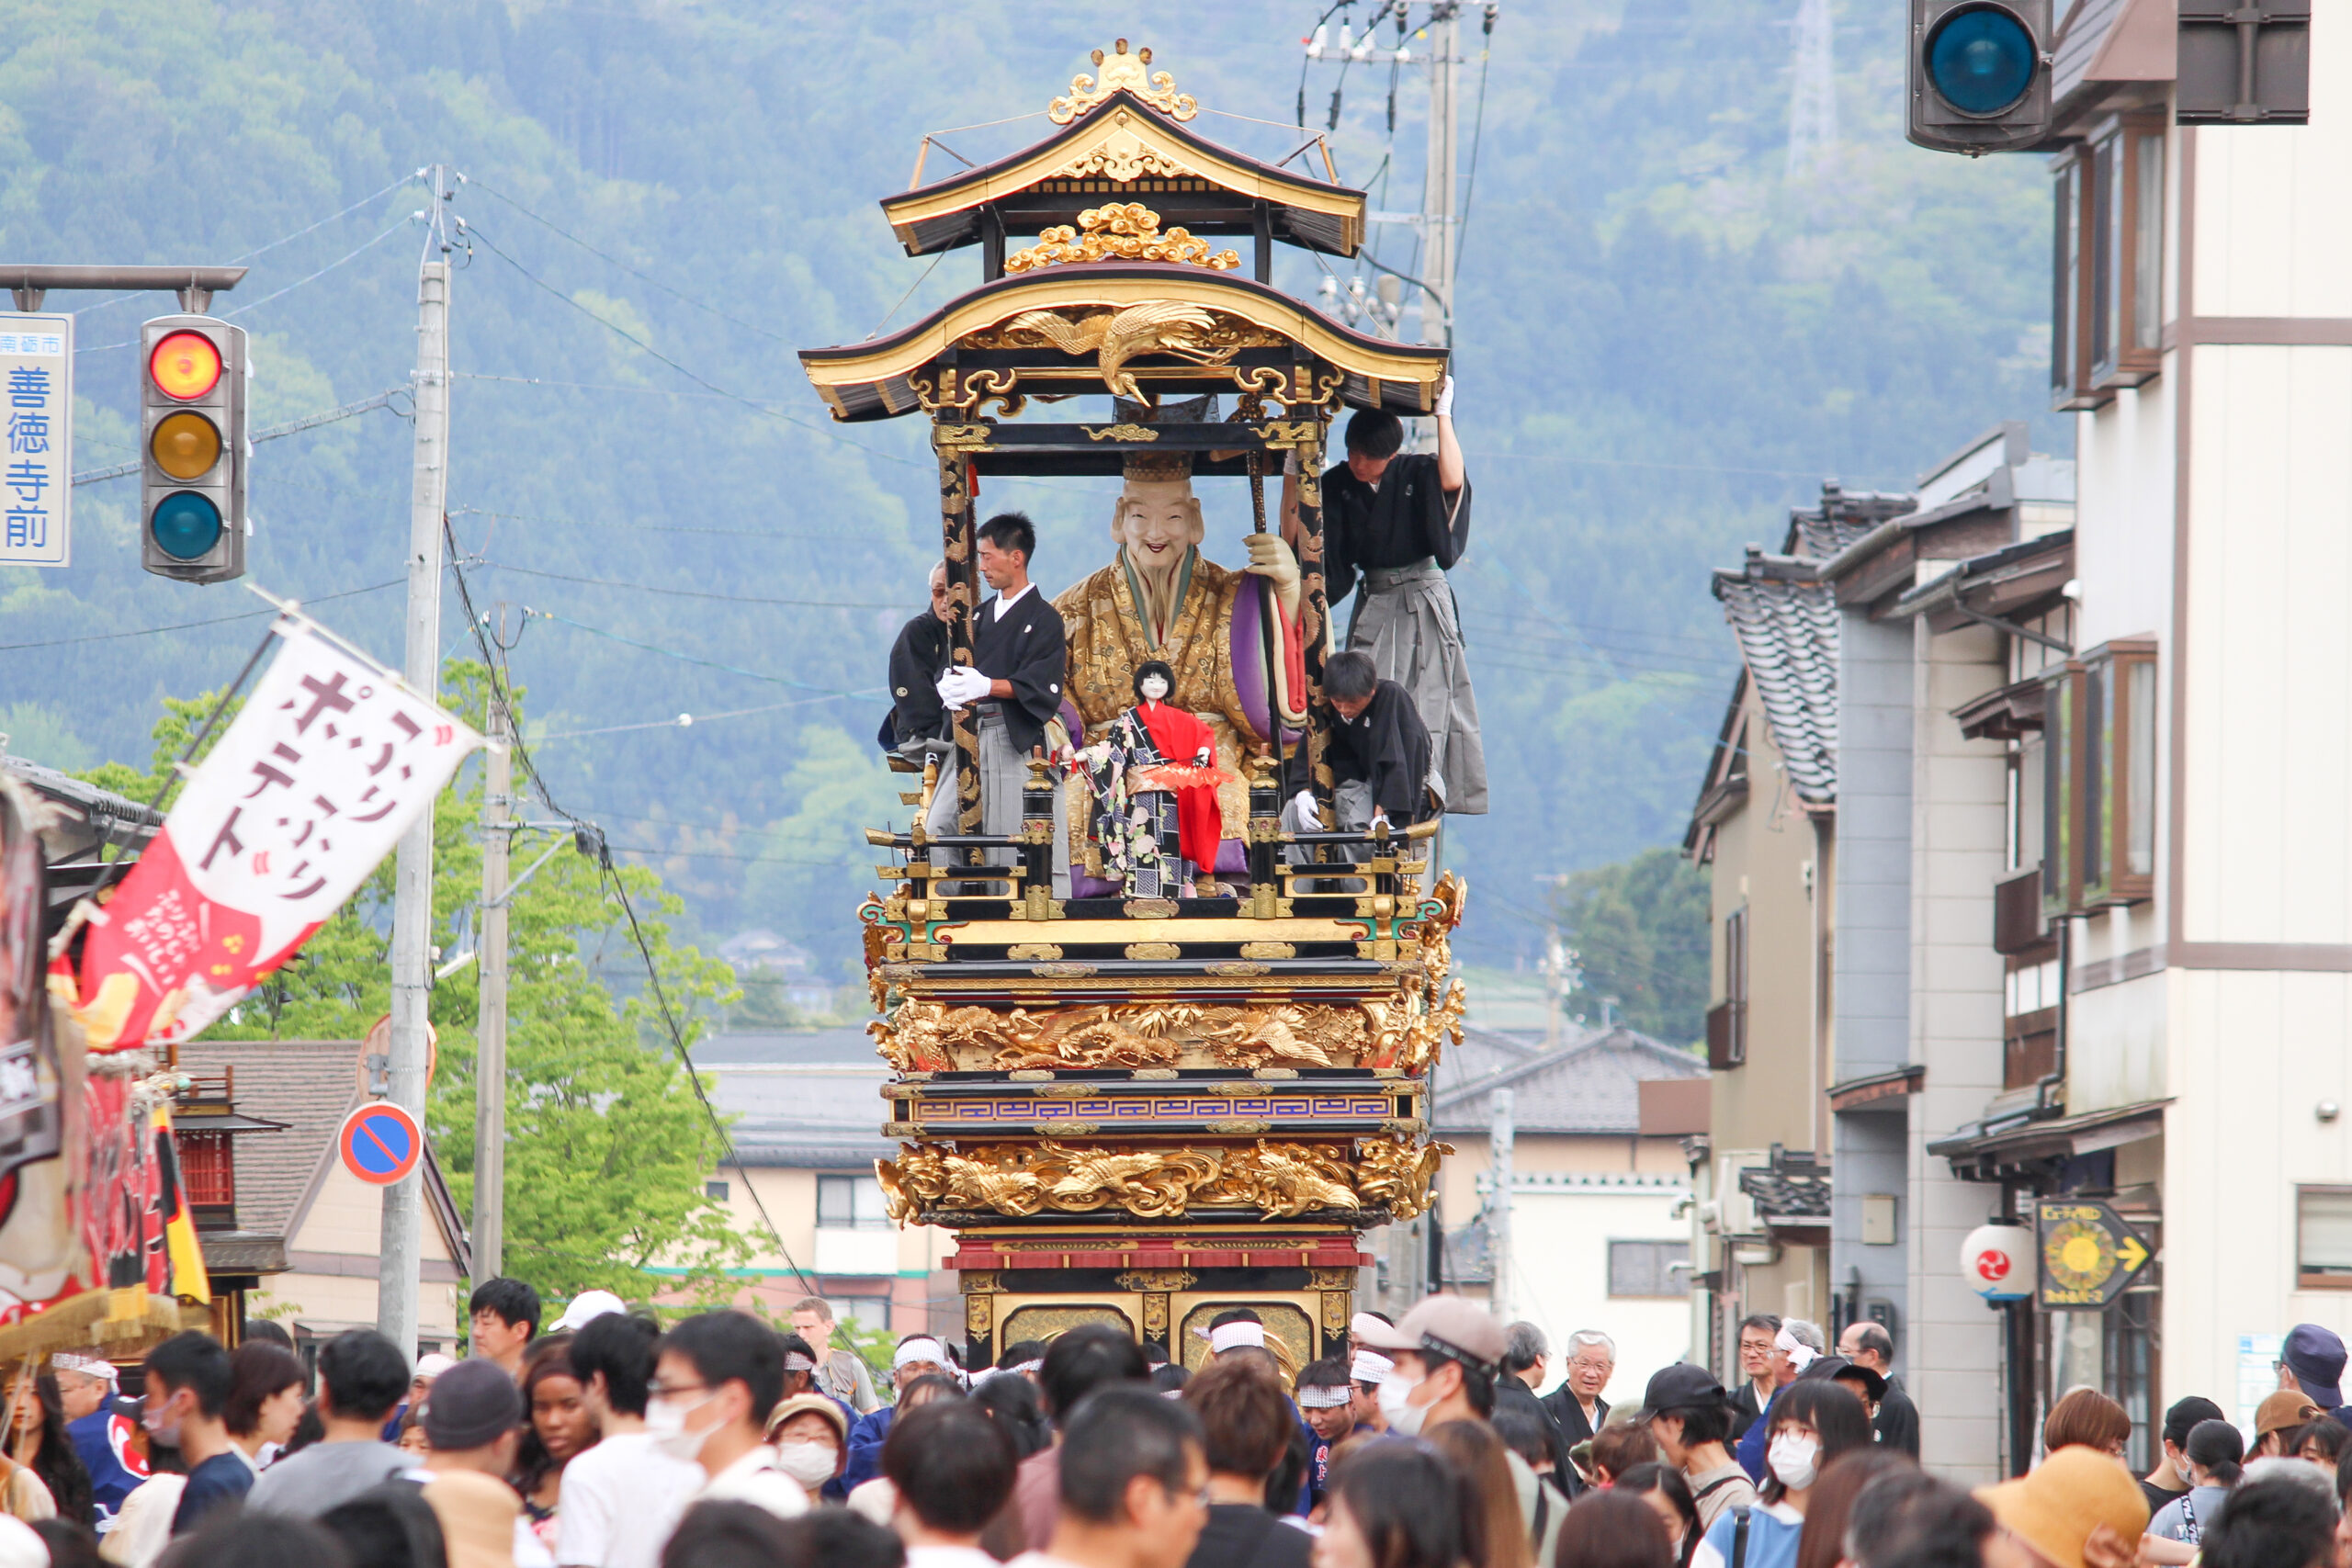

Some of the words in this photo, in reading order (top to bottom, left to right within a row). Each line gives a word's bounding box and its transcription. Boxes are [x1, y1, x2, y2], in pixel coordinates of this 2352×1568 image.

[5, 366, 51, 548] 善徳寺前
[200, 671, 374, 871] ポテト
